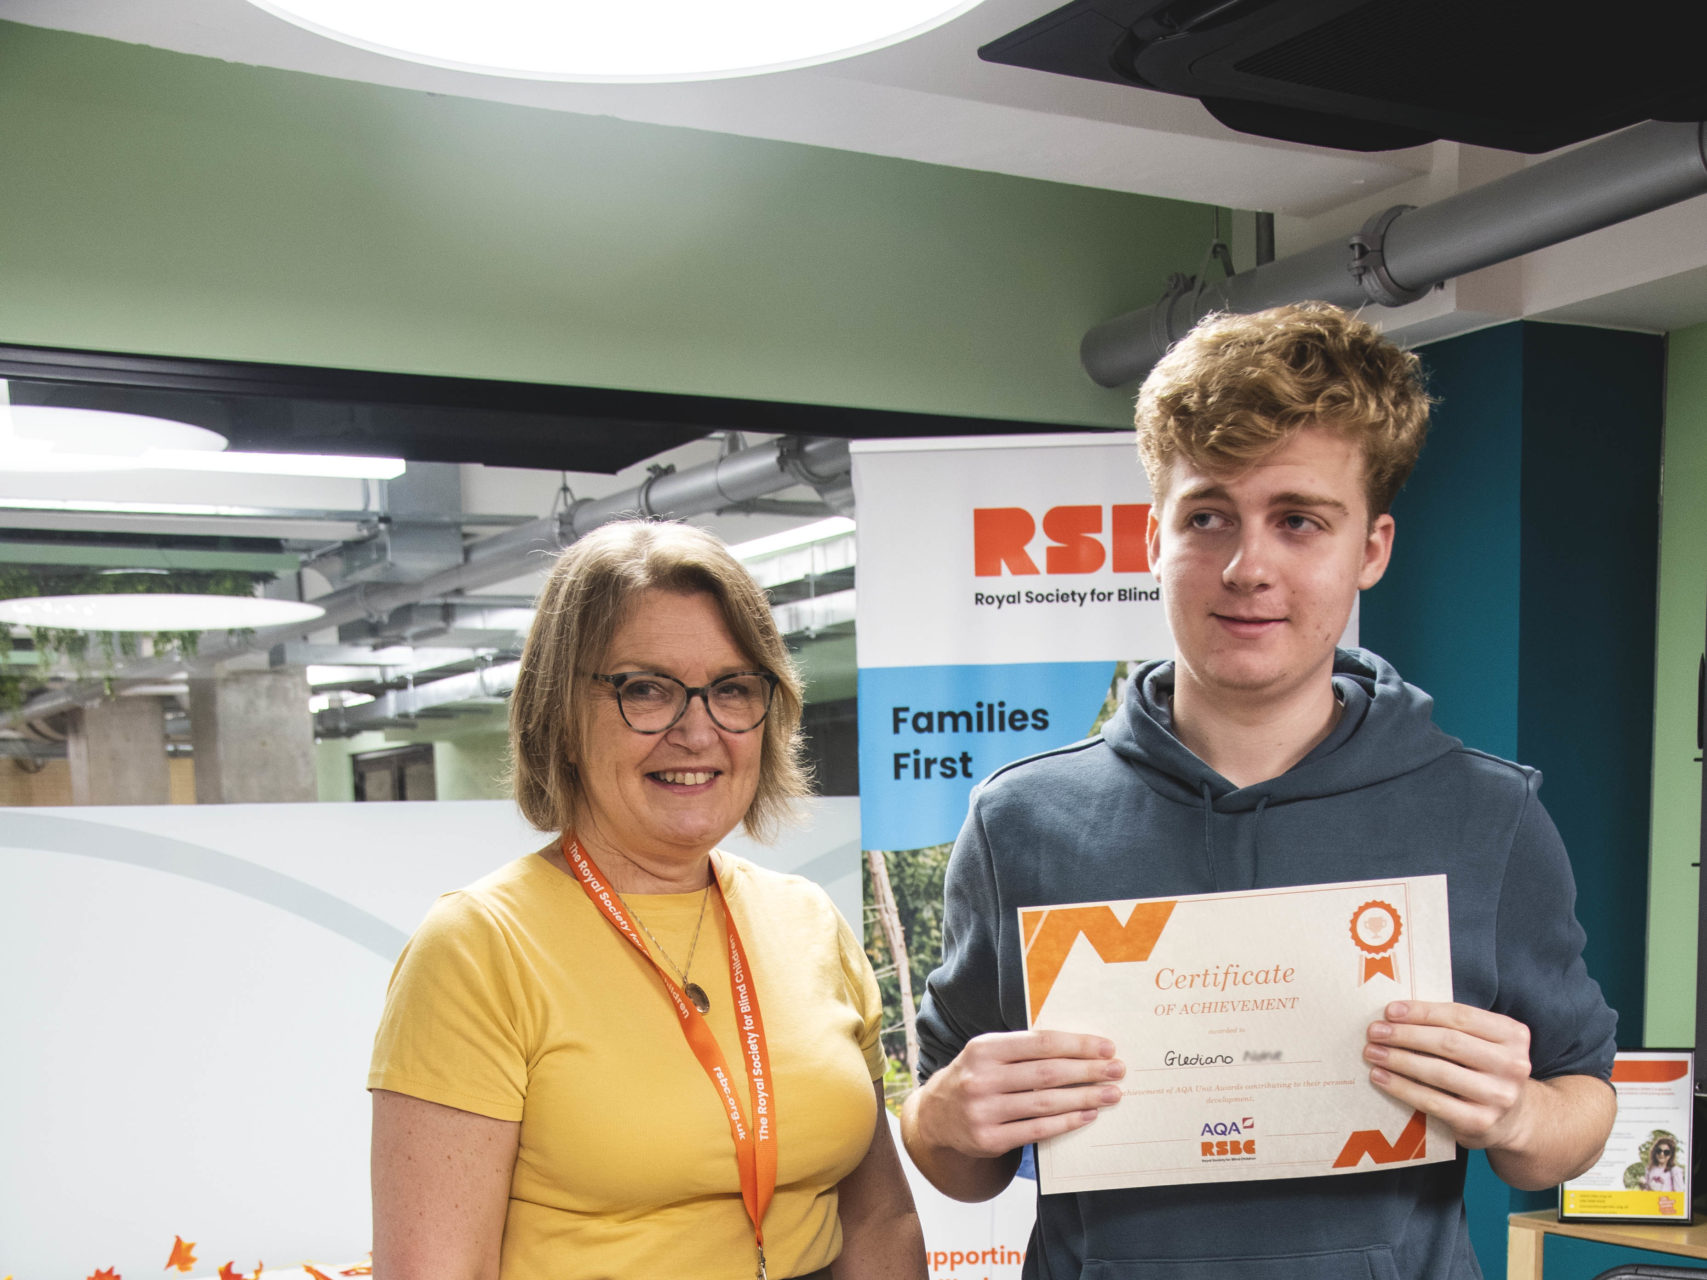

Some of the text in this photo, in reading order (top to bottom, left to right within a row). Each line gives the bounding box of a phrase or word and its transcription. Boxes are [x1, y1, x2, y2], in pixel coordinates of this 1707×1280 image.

[974, 504, 1152, 577] RSB
[974, 587, 1160, 609] Royal Society for Blind
[892, 701, 1050, 735] Families
[893, 750, 973, 780] First
[568, 841, 581, 863] The
[578, 860, 605, 893] Royal
[599, 891, 632, 932] Society
[1154, 963, 1297, 992] Certificate
[1154, 997, 1300, 1016] OF ACHIEVEMENT
[729, 934, 769, 1141] The Royal Society for Blind Children
[713, 1066, 746, 1141] rsbc.org.uk
[1200, 1121, 1241, 1136] AQA
[1201, 1139, 1256, 1156] RSBC
[926, 1245, 1026, 1271] pportin
